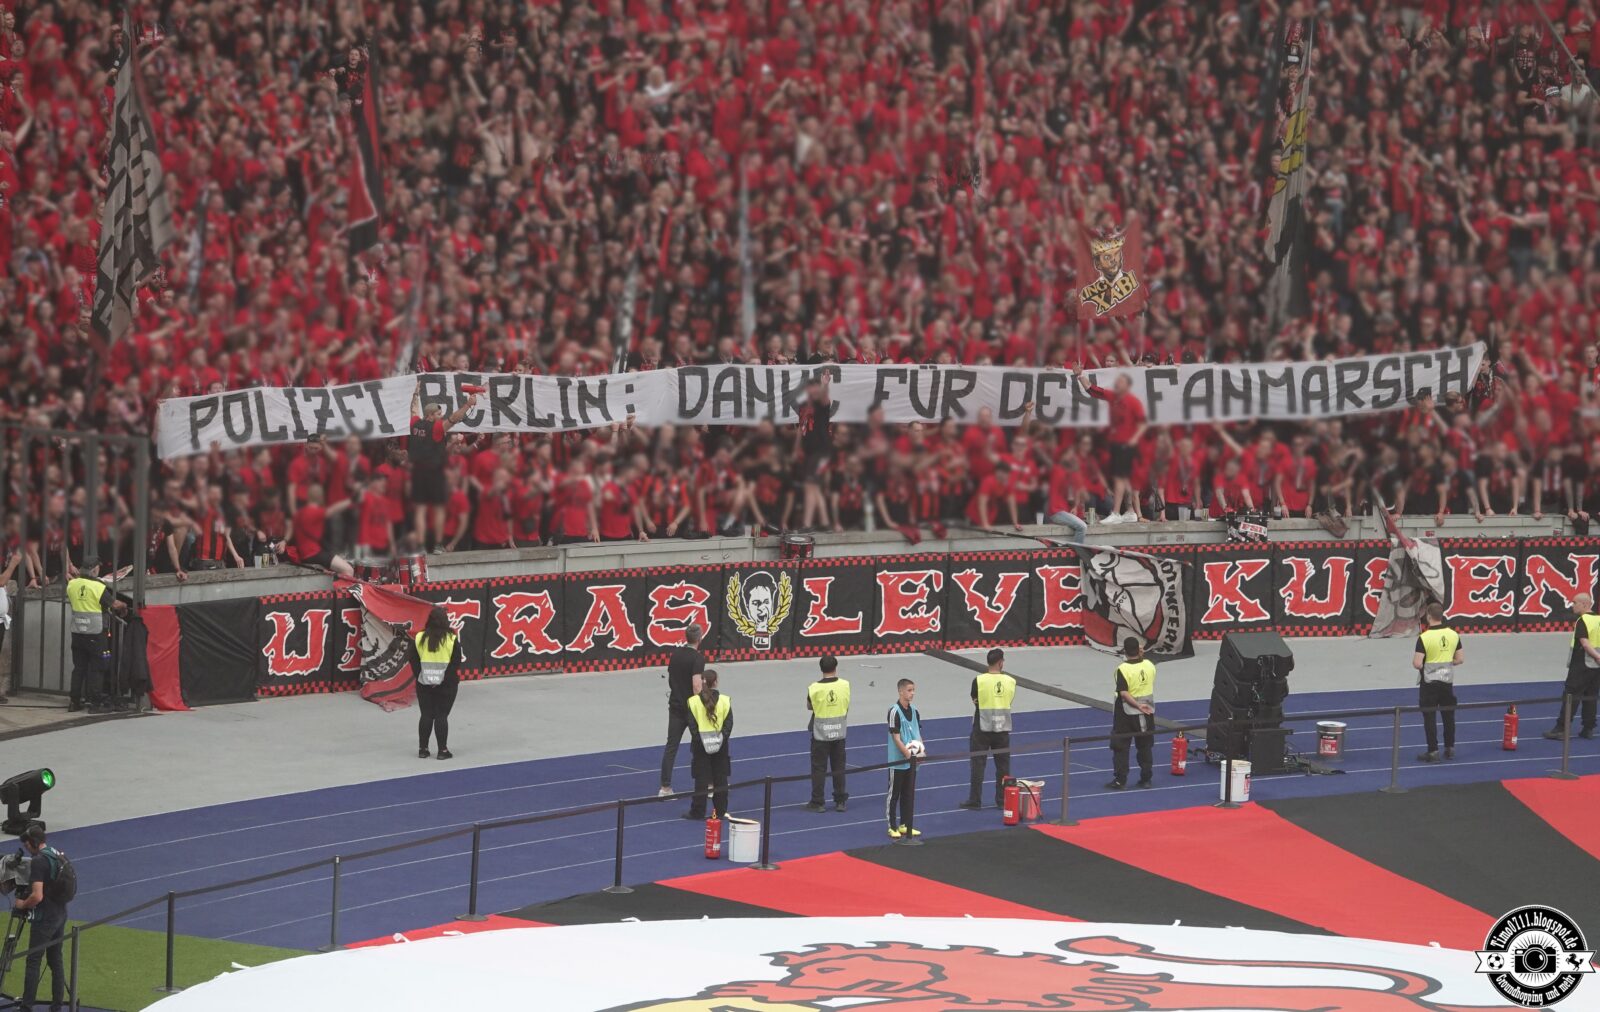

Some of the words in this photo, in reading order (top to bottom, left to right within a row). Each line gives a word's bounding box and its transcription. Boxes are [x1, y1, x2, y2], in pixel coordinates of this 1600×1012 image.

[1091, 271, 1138, 313] XABI
[189, 382, 395, 450] POLIZEI
[874, 364, 977, 420] FÜR
[999, 371, 1099, 423] DEN
[1145, 348, 1474, 421] FANMARSCH
[800, 553, 1599, 637] LEVEKUEN
